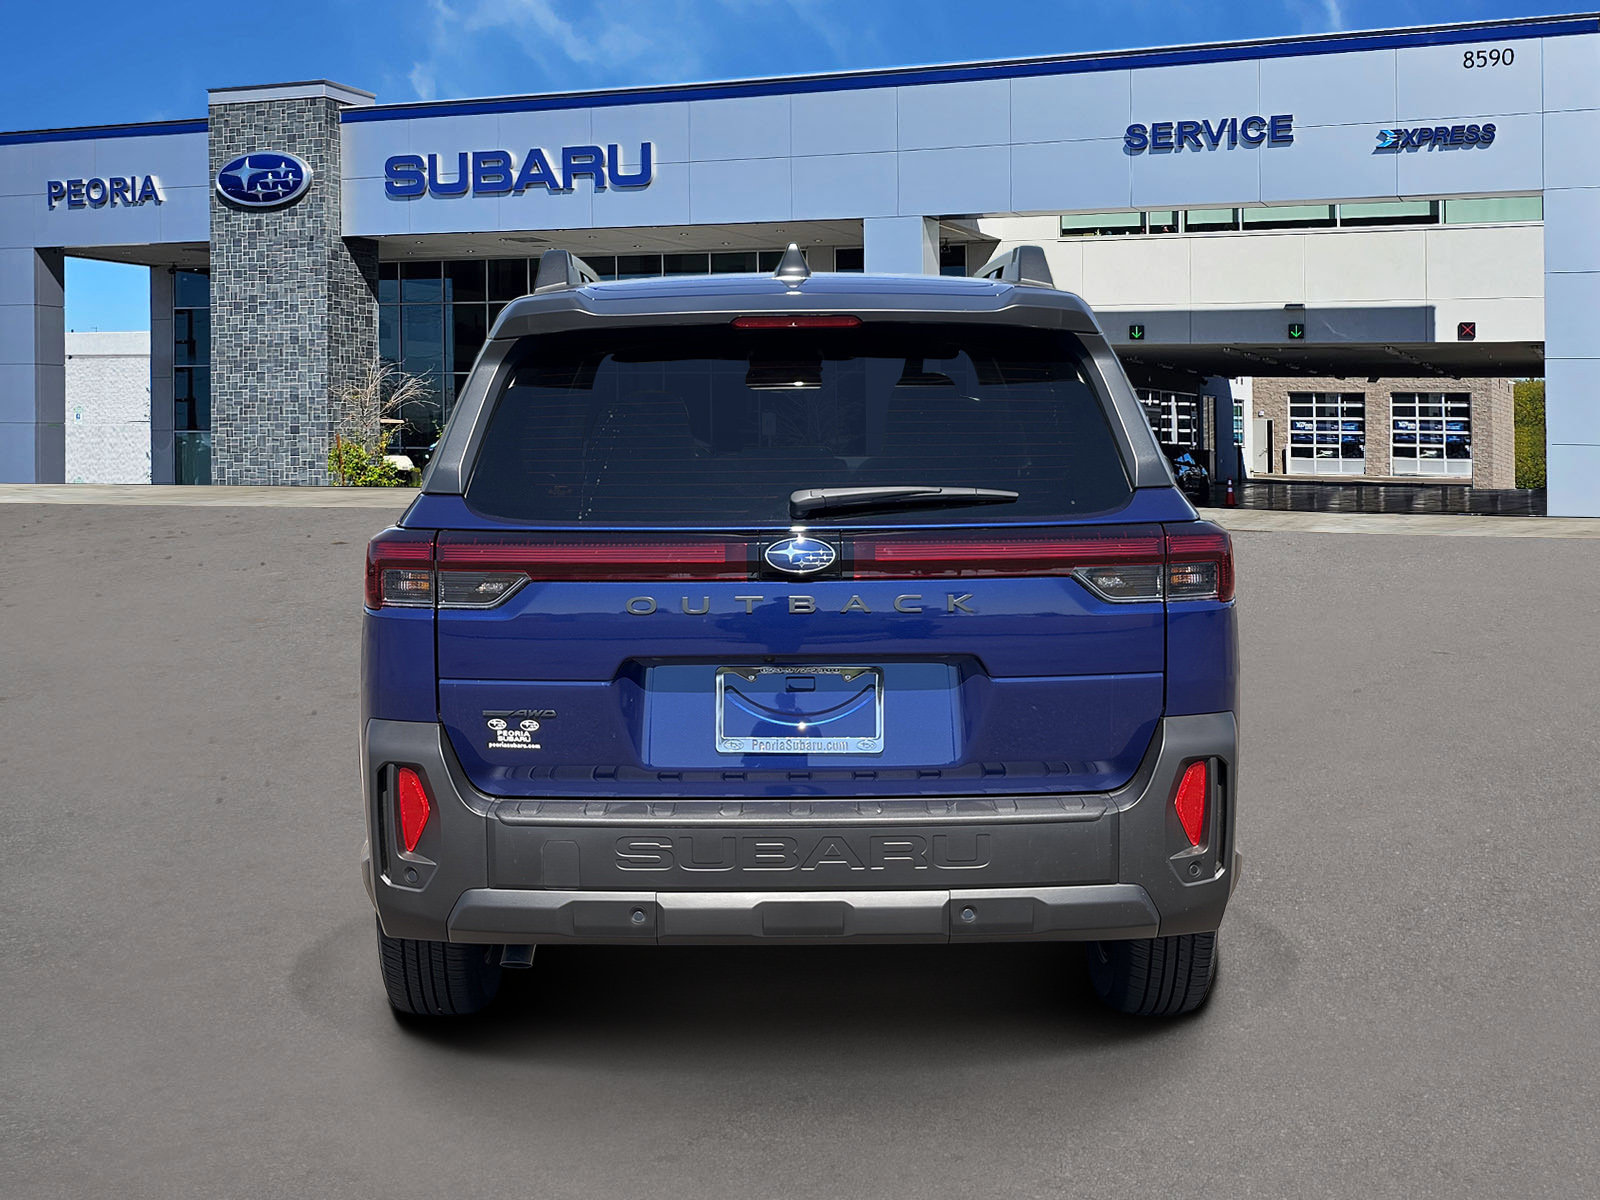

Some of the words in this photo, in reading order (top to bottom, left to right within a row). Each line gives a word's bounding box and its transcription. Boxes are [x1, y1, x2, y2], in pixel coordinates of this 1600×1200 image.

[1463, 48, 1515, 69] 8590
[1124, 114, 1295, 152] SERVICE
[1376, 123, 1497, 150] EXPRESS
[384, 142, 653, 198] SUBARU
[47, 175, 163, 210] PEORIA
[625, 594, 976, 616] OUTBACK
[511, 709, 557, 717] AWD
[751, 739, 849, 752] PeoriaSubaru.com
[615, 834, 992, 872] SUBARU
